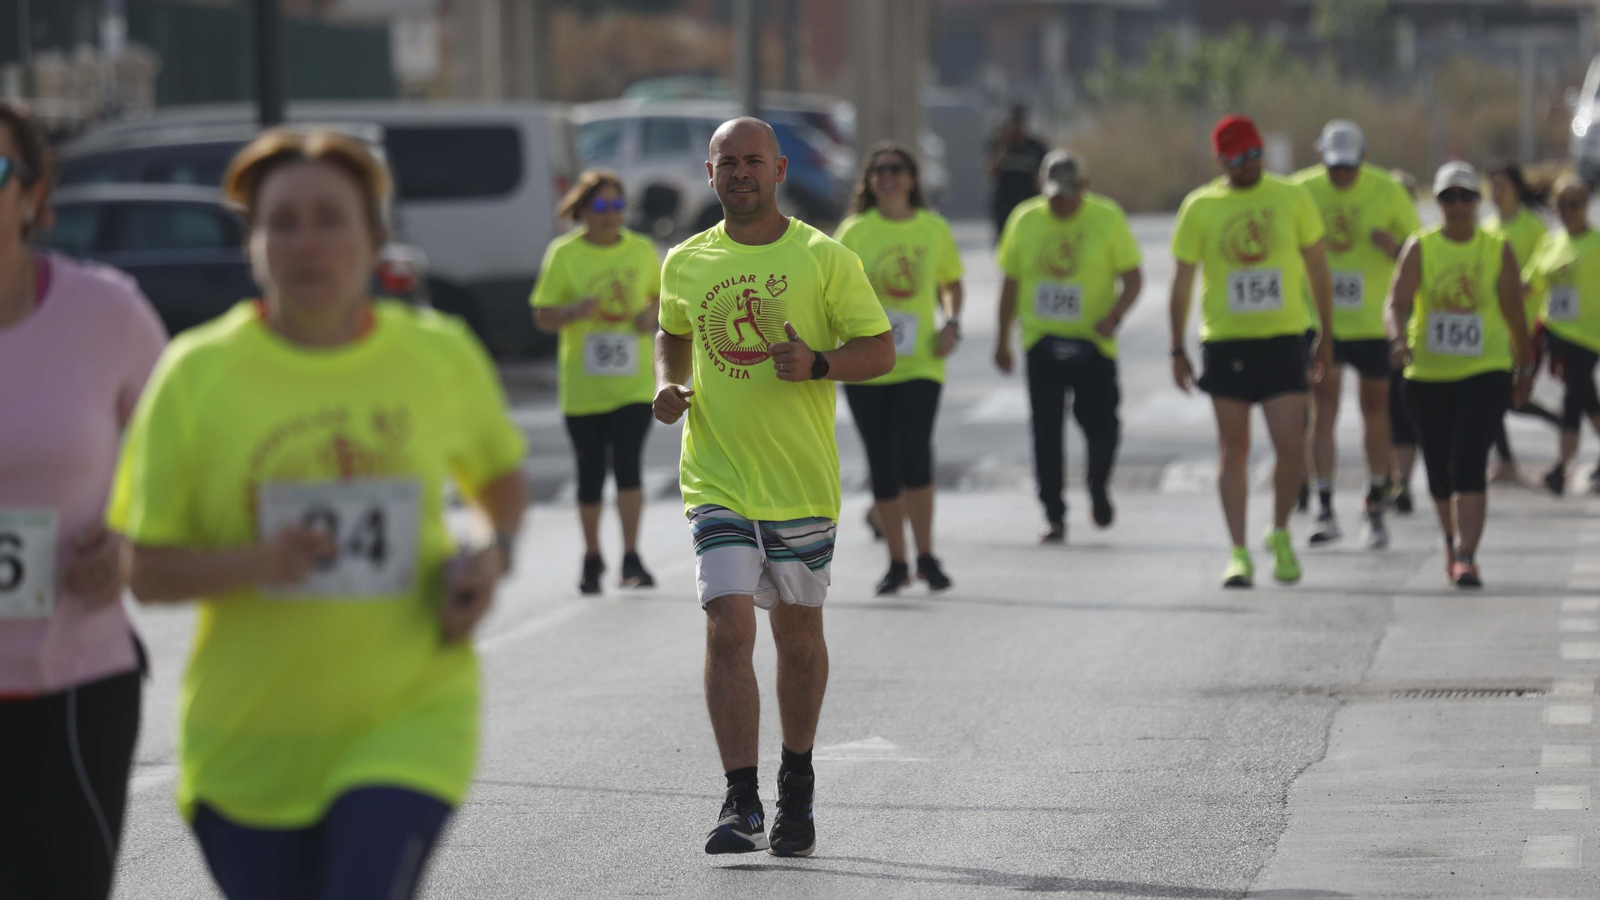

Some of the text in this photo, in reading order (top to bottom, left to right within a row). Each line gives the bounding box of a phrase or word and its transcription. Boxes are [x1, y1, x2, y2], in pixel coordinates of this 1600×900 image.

[1235, 275, 1280, 304] 154
[697, 274, 757, 379] VII CARRERA POPULAR
[1435, 318, 1481, 348] 150
[723, 352, 740, 364] PUENTE
